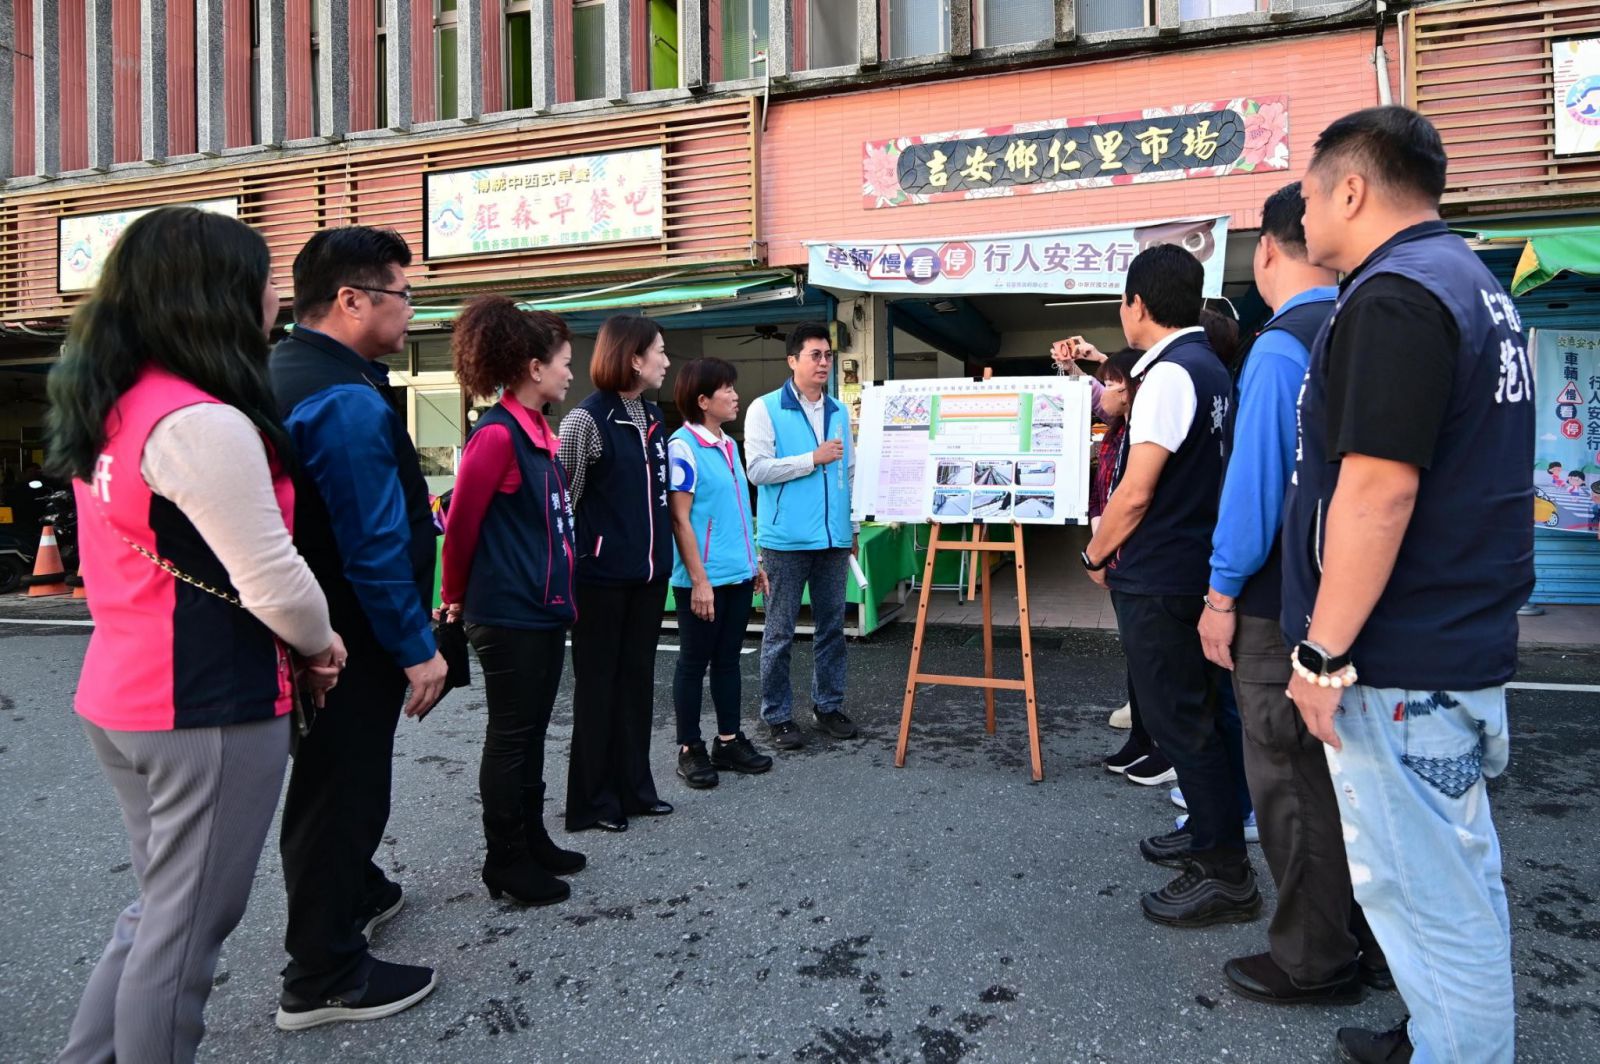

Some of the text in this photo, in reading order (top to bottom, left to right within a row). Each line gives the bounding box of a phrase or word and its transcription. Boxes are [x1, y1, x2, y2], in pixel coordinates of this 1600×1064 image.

[926, 120, 1219, 187] 吉安鄉仁里市場
[477, 170, 590, 195] 傳統中西式早餐
[983, 242, 1134, 273] 行人安全行
[1557, 335, 1600, 350] 交通安全
